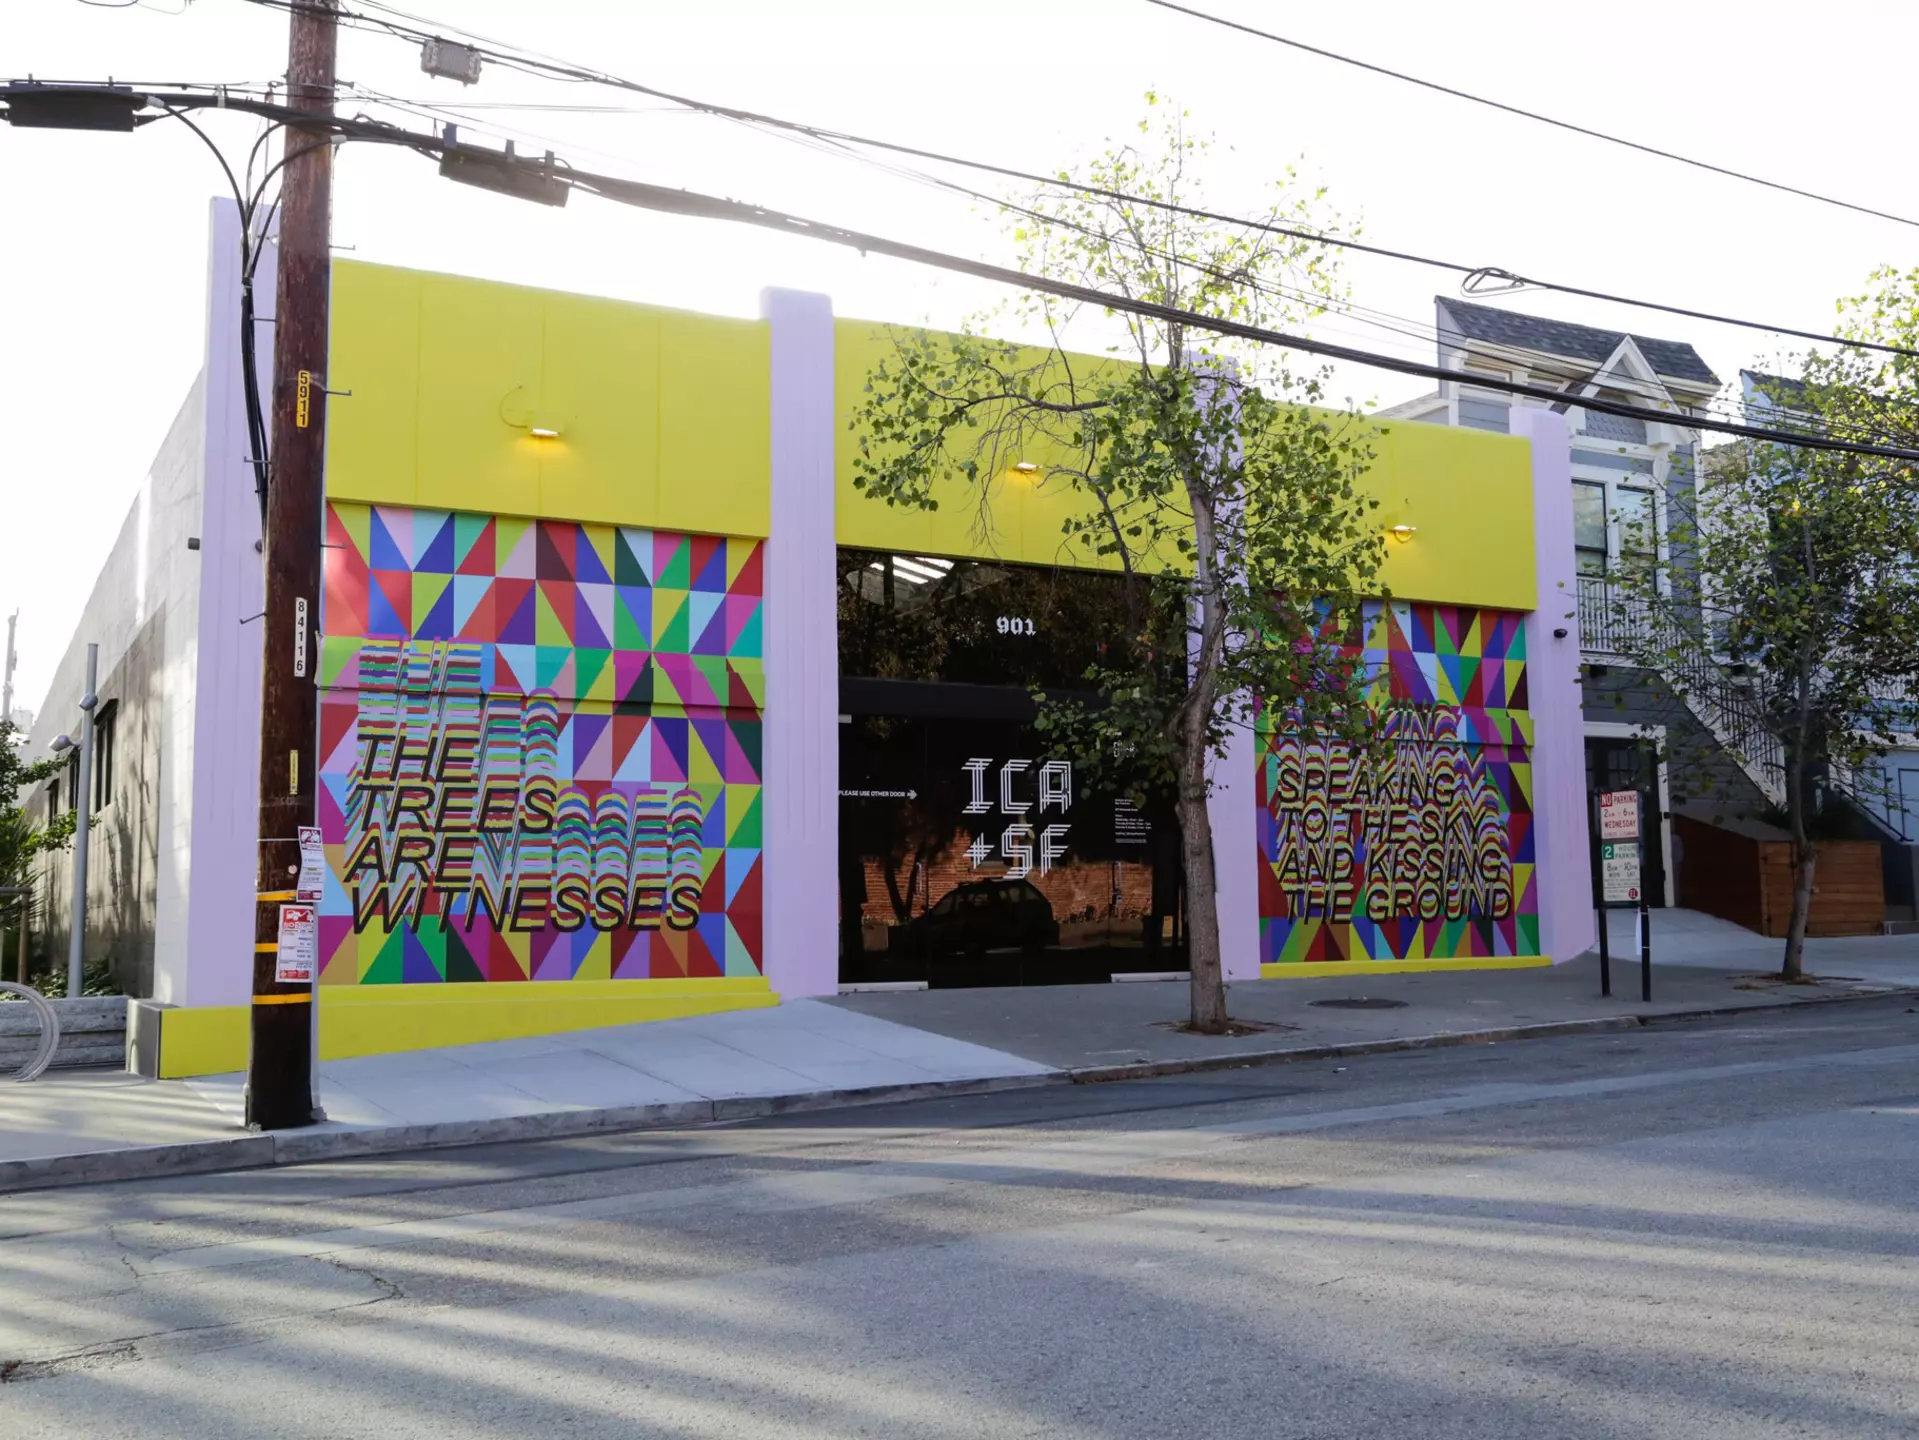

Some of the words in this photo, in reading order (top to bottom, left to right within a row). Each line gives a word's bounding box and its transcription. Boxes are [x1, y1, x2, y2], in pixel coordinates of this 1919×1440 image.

[299, 371, 308, 426] 5911
[296, 600, 305, 672] 84116
[996, 616, 1037, 636] 901
[357, 733, 479, 784] THE
[961, 757, 1072, 815] ICA
[1278, 768, 1456, 806] SPEAKING
[1601, 793, 1611, 806] NO
[1613, 794, 1637, 805] PARKING
[356, 784, 557, 834] TREES
[1281, 807, 1328, 843] TO
[1342, 808, 1409, 843] THE
[1420, 810, 1486, 843] SKY
[1604, 820, 1636, 829] WEDNESDAY
[343, 836, 478, 884] ARE
[1278, 848, 1355, 883] AND
[1366, 847, 1502, 883] KISSING
[1605, 846, 1612, 858] 2
[351, 885, 702, 935] WITNESSES
[1283, 889, 1352, 925] THE
[1365, 888, 1512, 924] GROUND
